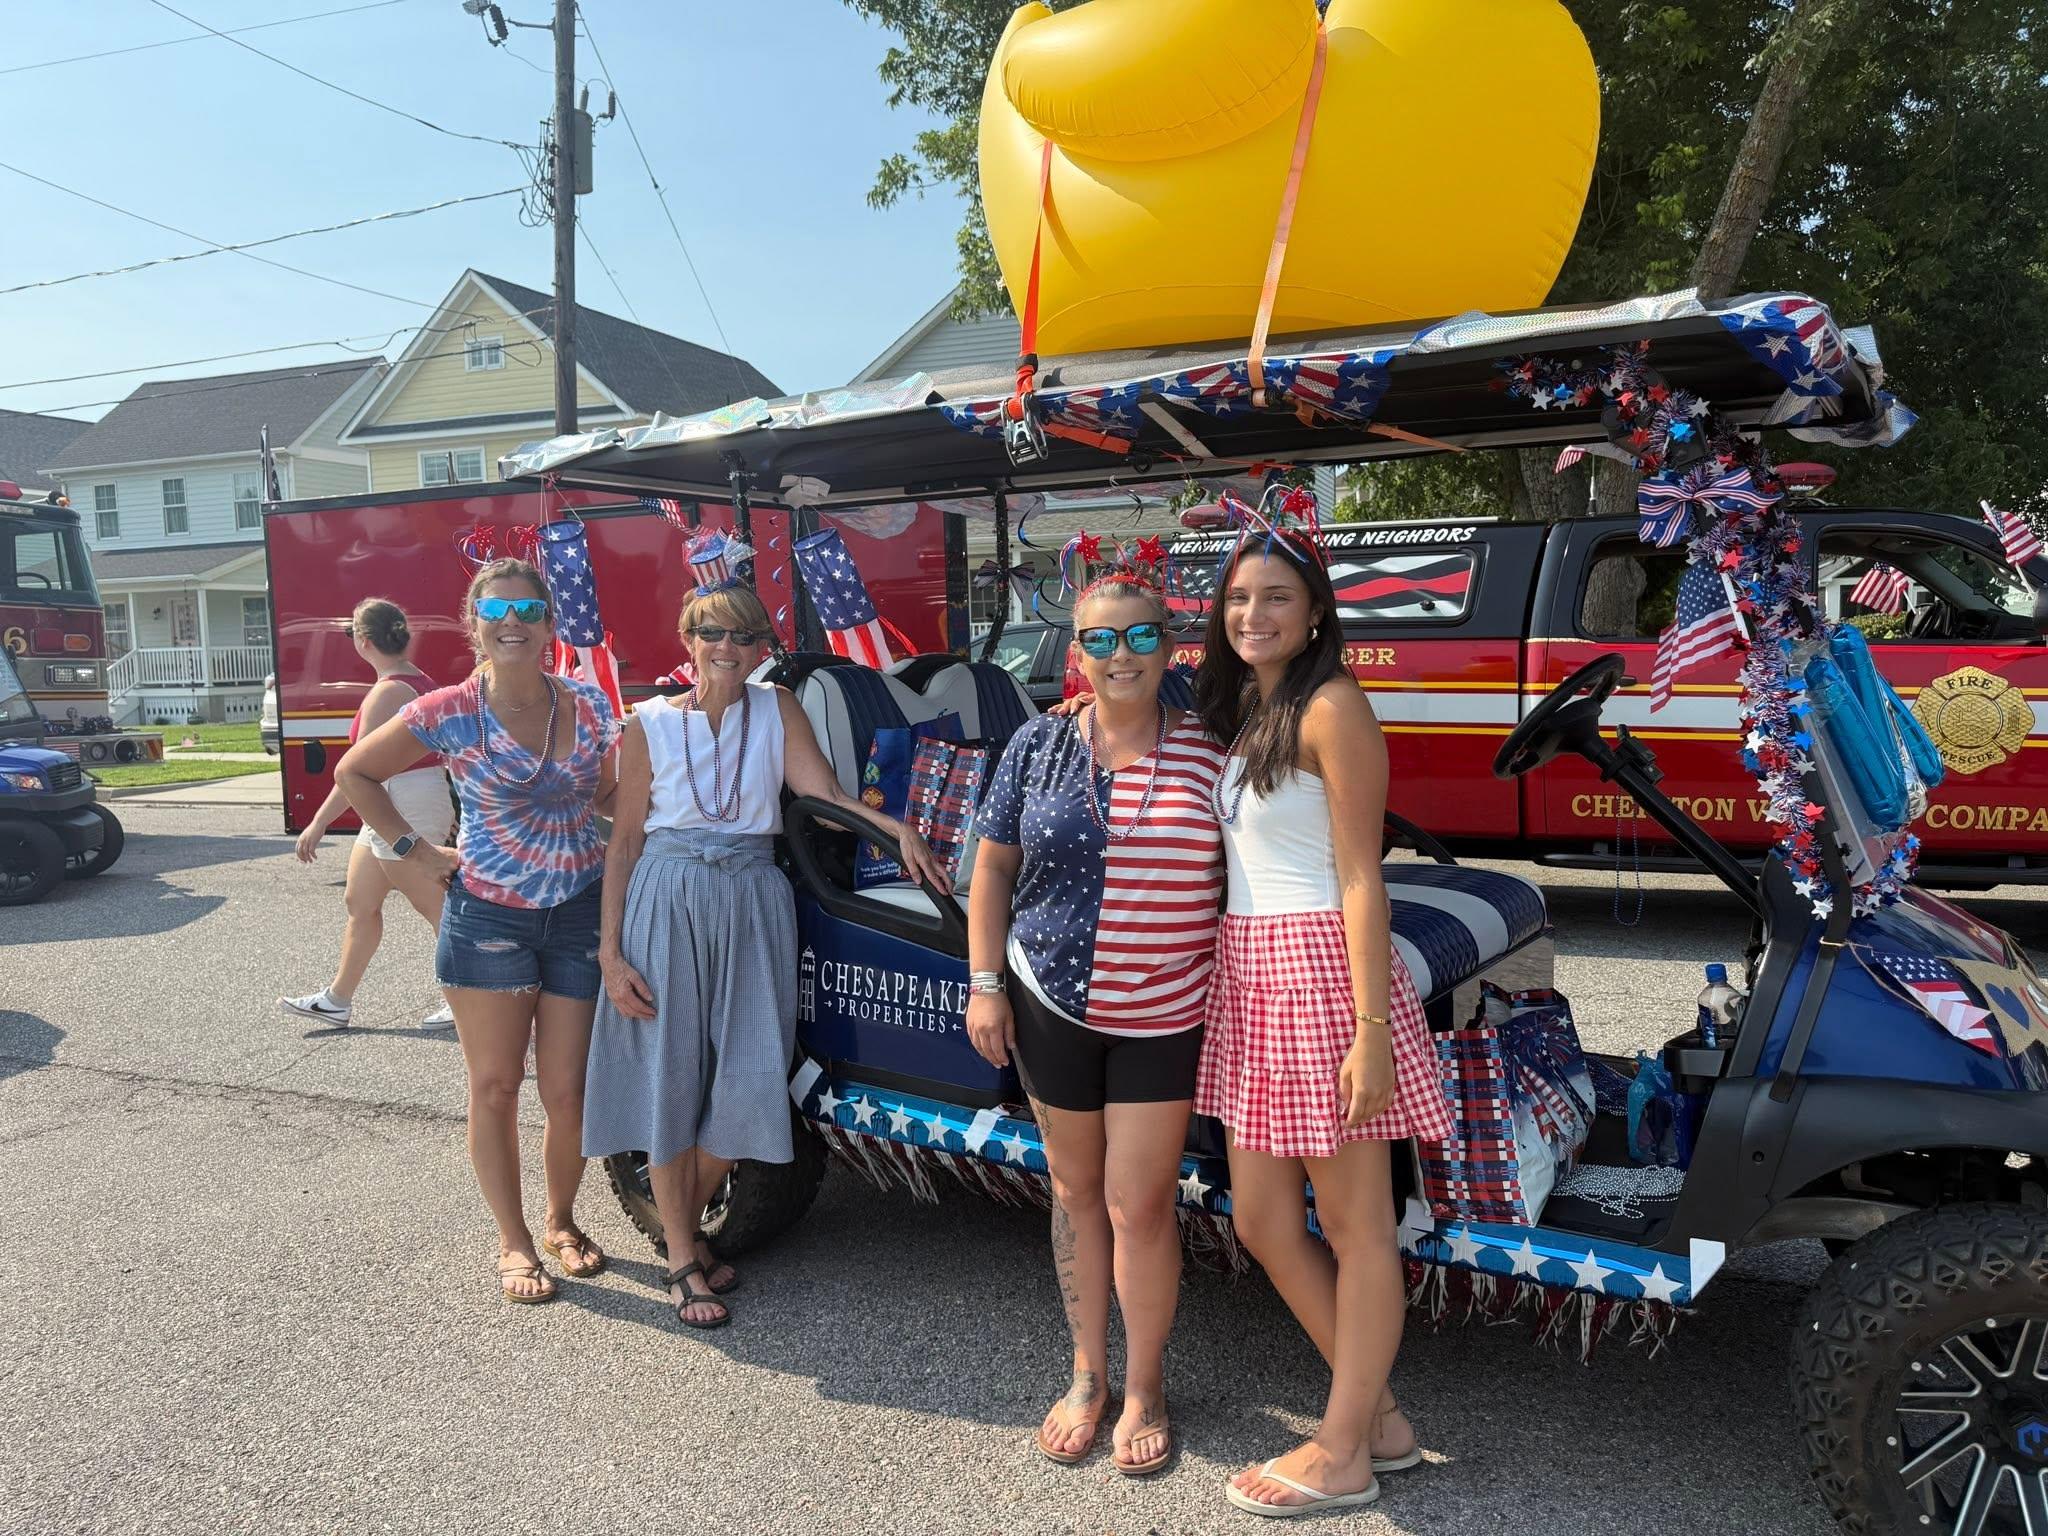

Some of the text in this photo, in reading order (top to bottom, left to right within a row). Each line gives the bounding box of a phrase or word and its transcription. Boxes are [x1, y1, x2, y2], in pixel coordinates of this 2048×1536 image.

[1360, 526, 1477, 546] NEIGHBORS
[3, 626, 28, 655] 6
[1945, 675, 1993, 690] FIRE
[1940, 749, 1996, 765] RESCUE
[1571, 794, 1737, 822] CHETON
[821, 960, 969, 1015] CHESAPEAKE
[838, 997, 947, 1034] PROPERTIES
